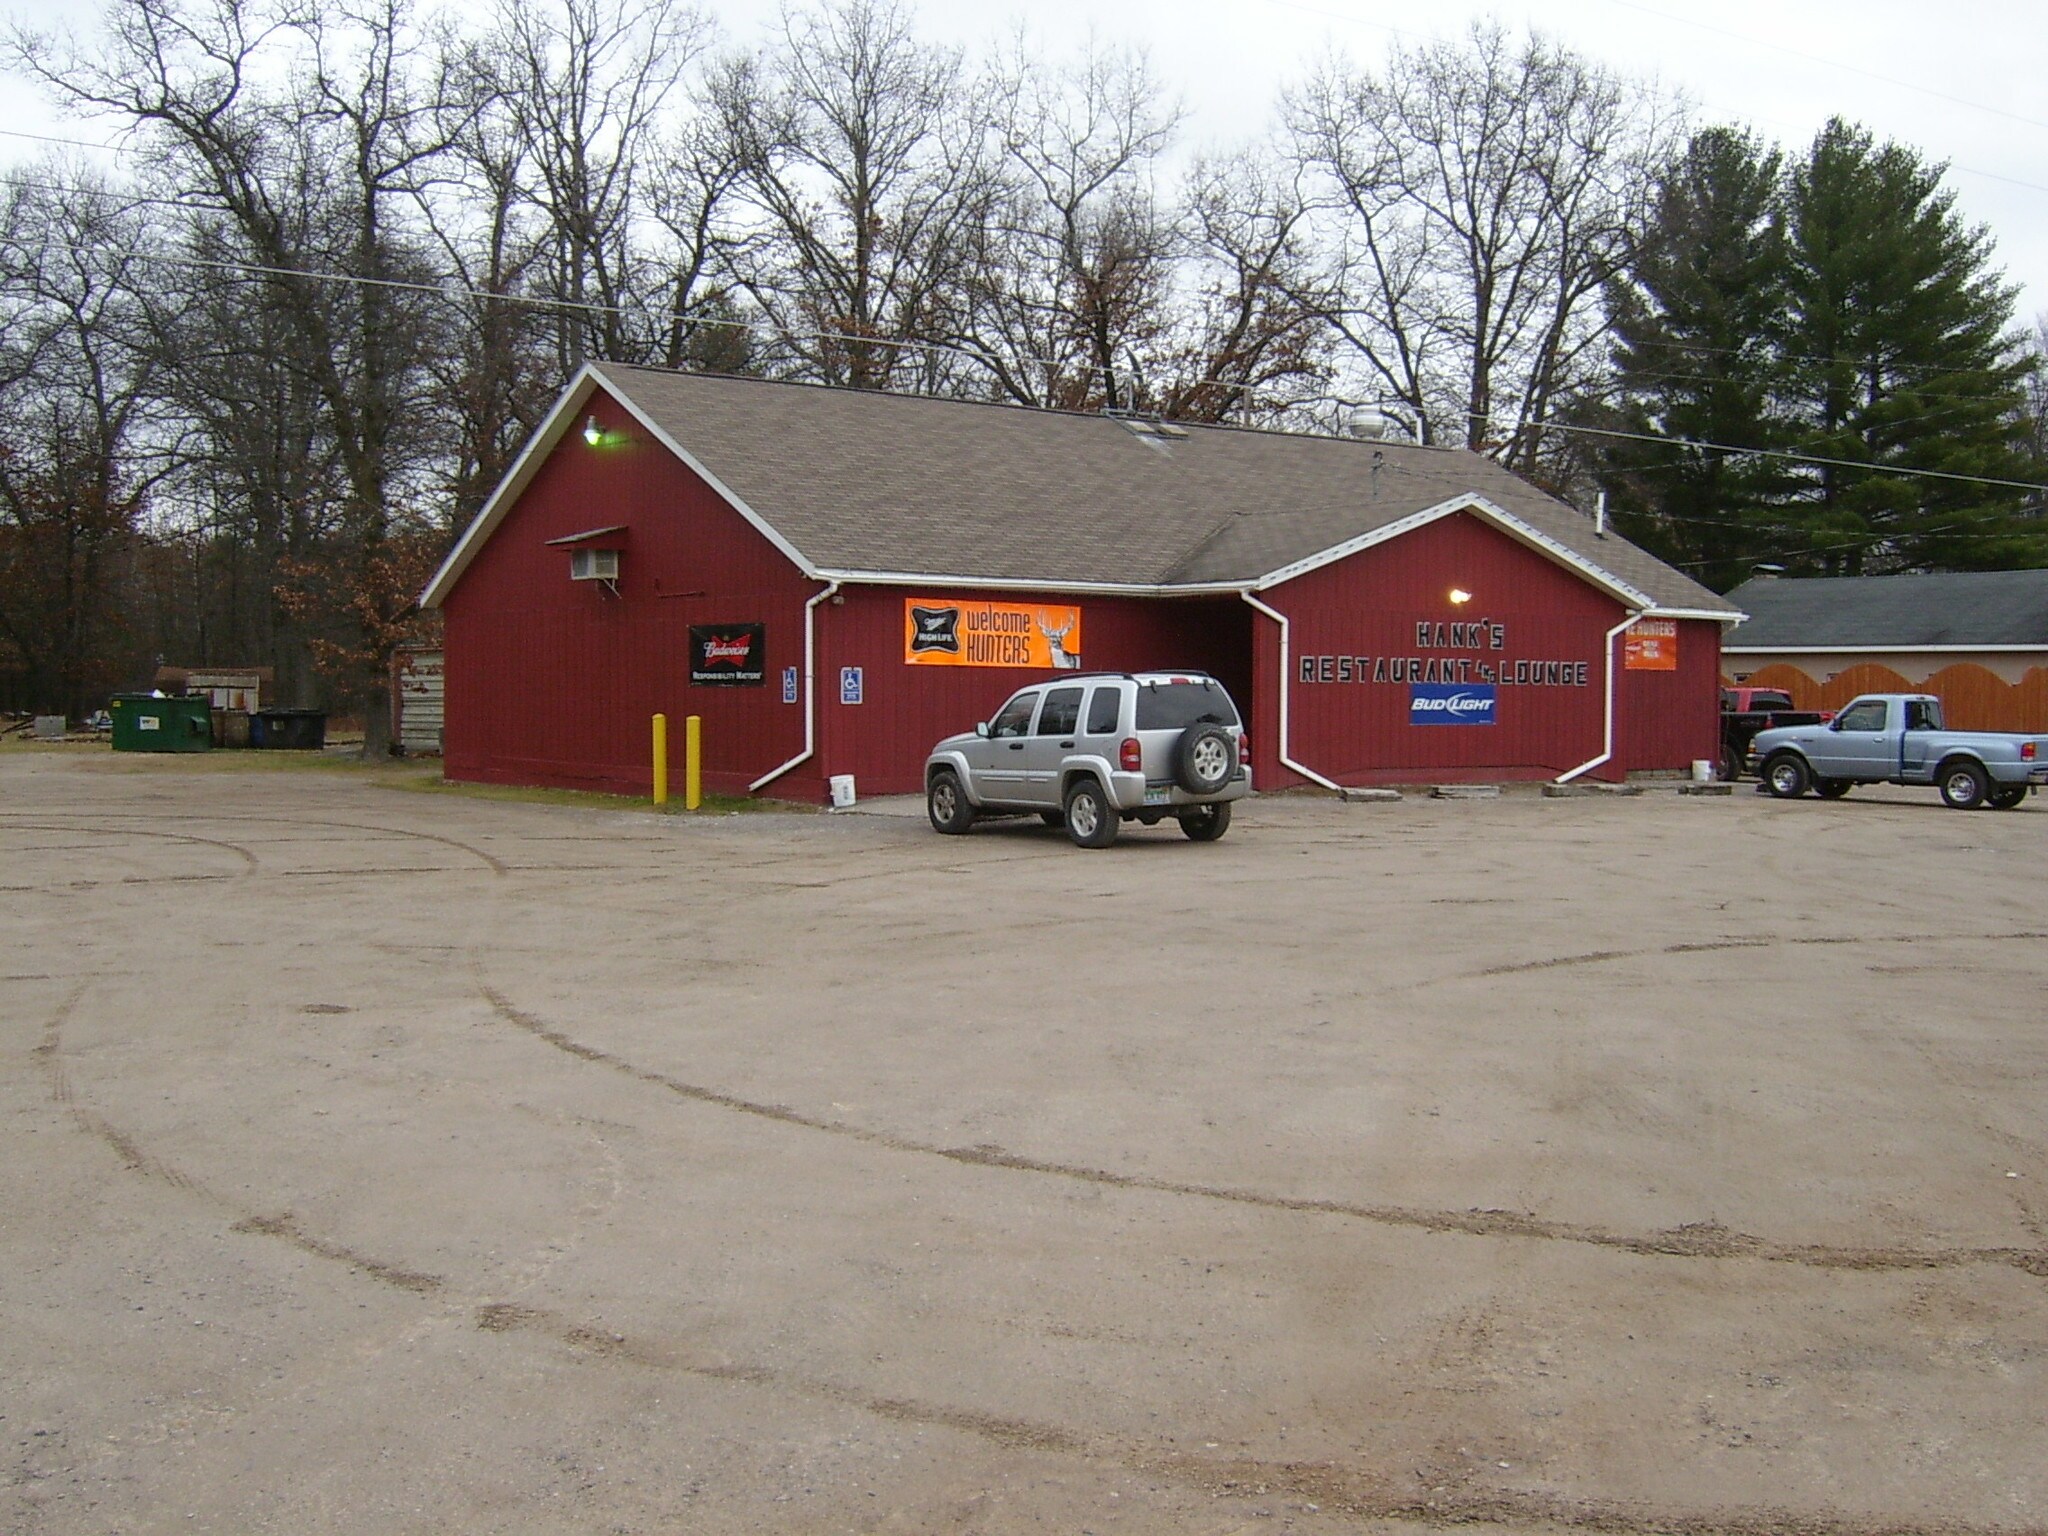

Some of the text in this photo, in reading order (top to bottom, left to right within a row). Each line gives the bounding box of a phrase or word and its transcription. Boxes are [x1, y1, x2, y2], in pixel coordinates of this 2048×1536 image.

[966, 604, 1030, 633] welcome
[1416, 617, 1504, 650] HANK'S
[703, 641, 751, 658] Budweiser
[918, 632, 953, 642] HIGH LIFE
[966, 633, 1030, 664] HUNTERS
[1299, 655, 1472, 685] RESTAURANT
[1499, 660, 1588, 686] LOUNGE
